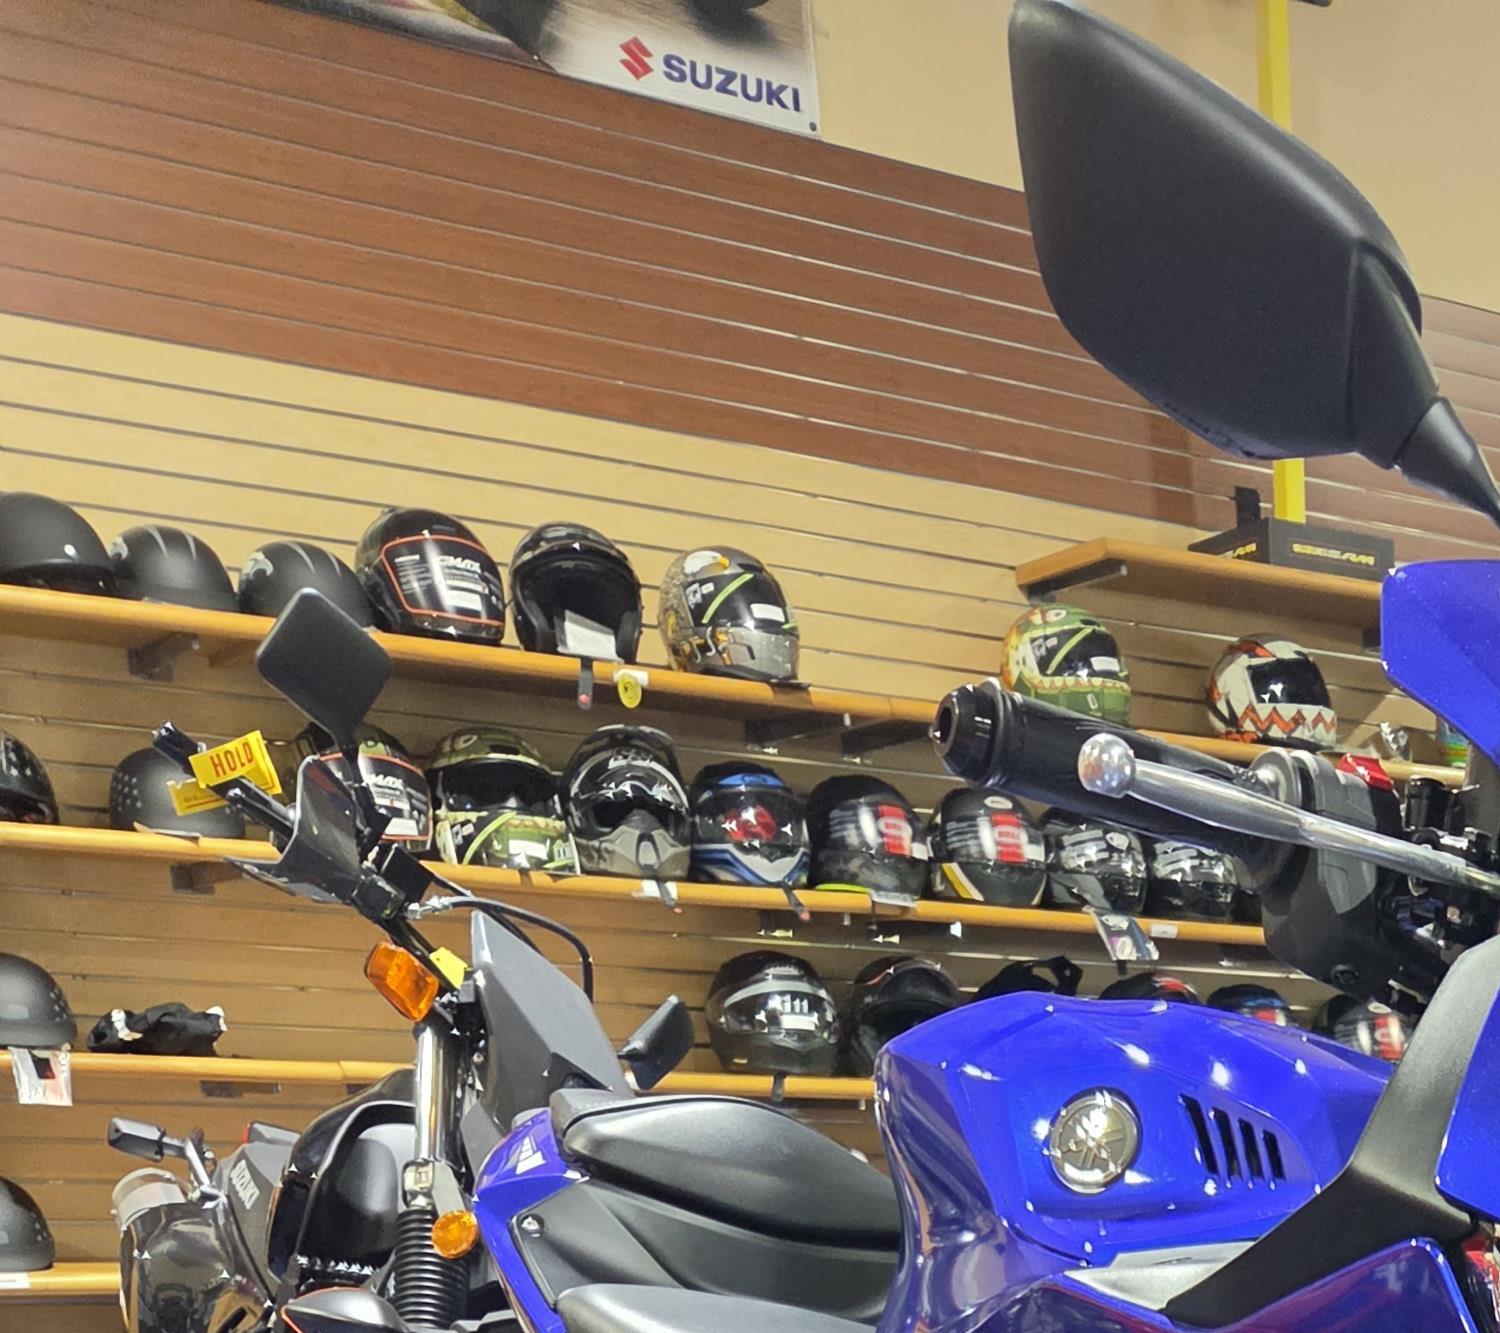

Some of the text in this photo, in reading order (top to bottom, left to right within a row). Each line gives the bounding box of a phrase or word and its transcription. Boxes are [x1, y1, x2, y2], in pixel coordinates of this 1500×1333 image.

[662, 53, 802, 113] SUZUKI
[209, 741, 254, 779] HOLD
[230, 1159, 260, 1210] SUZUKI
